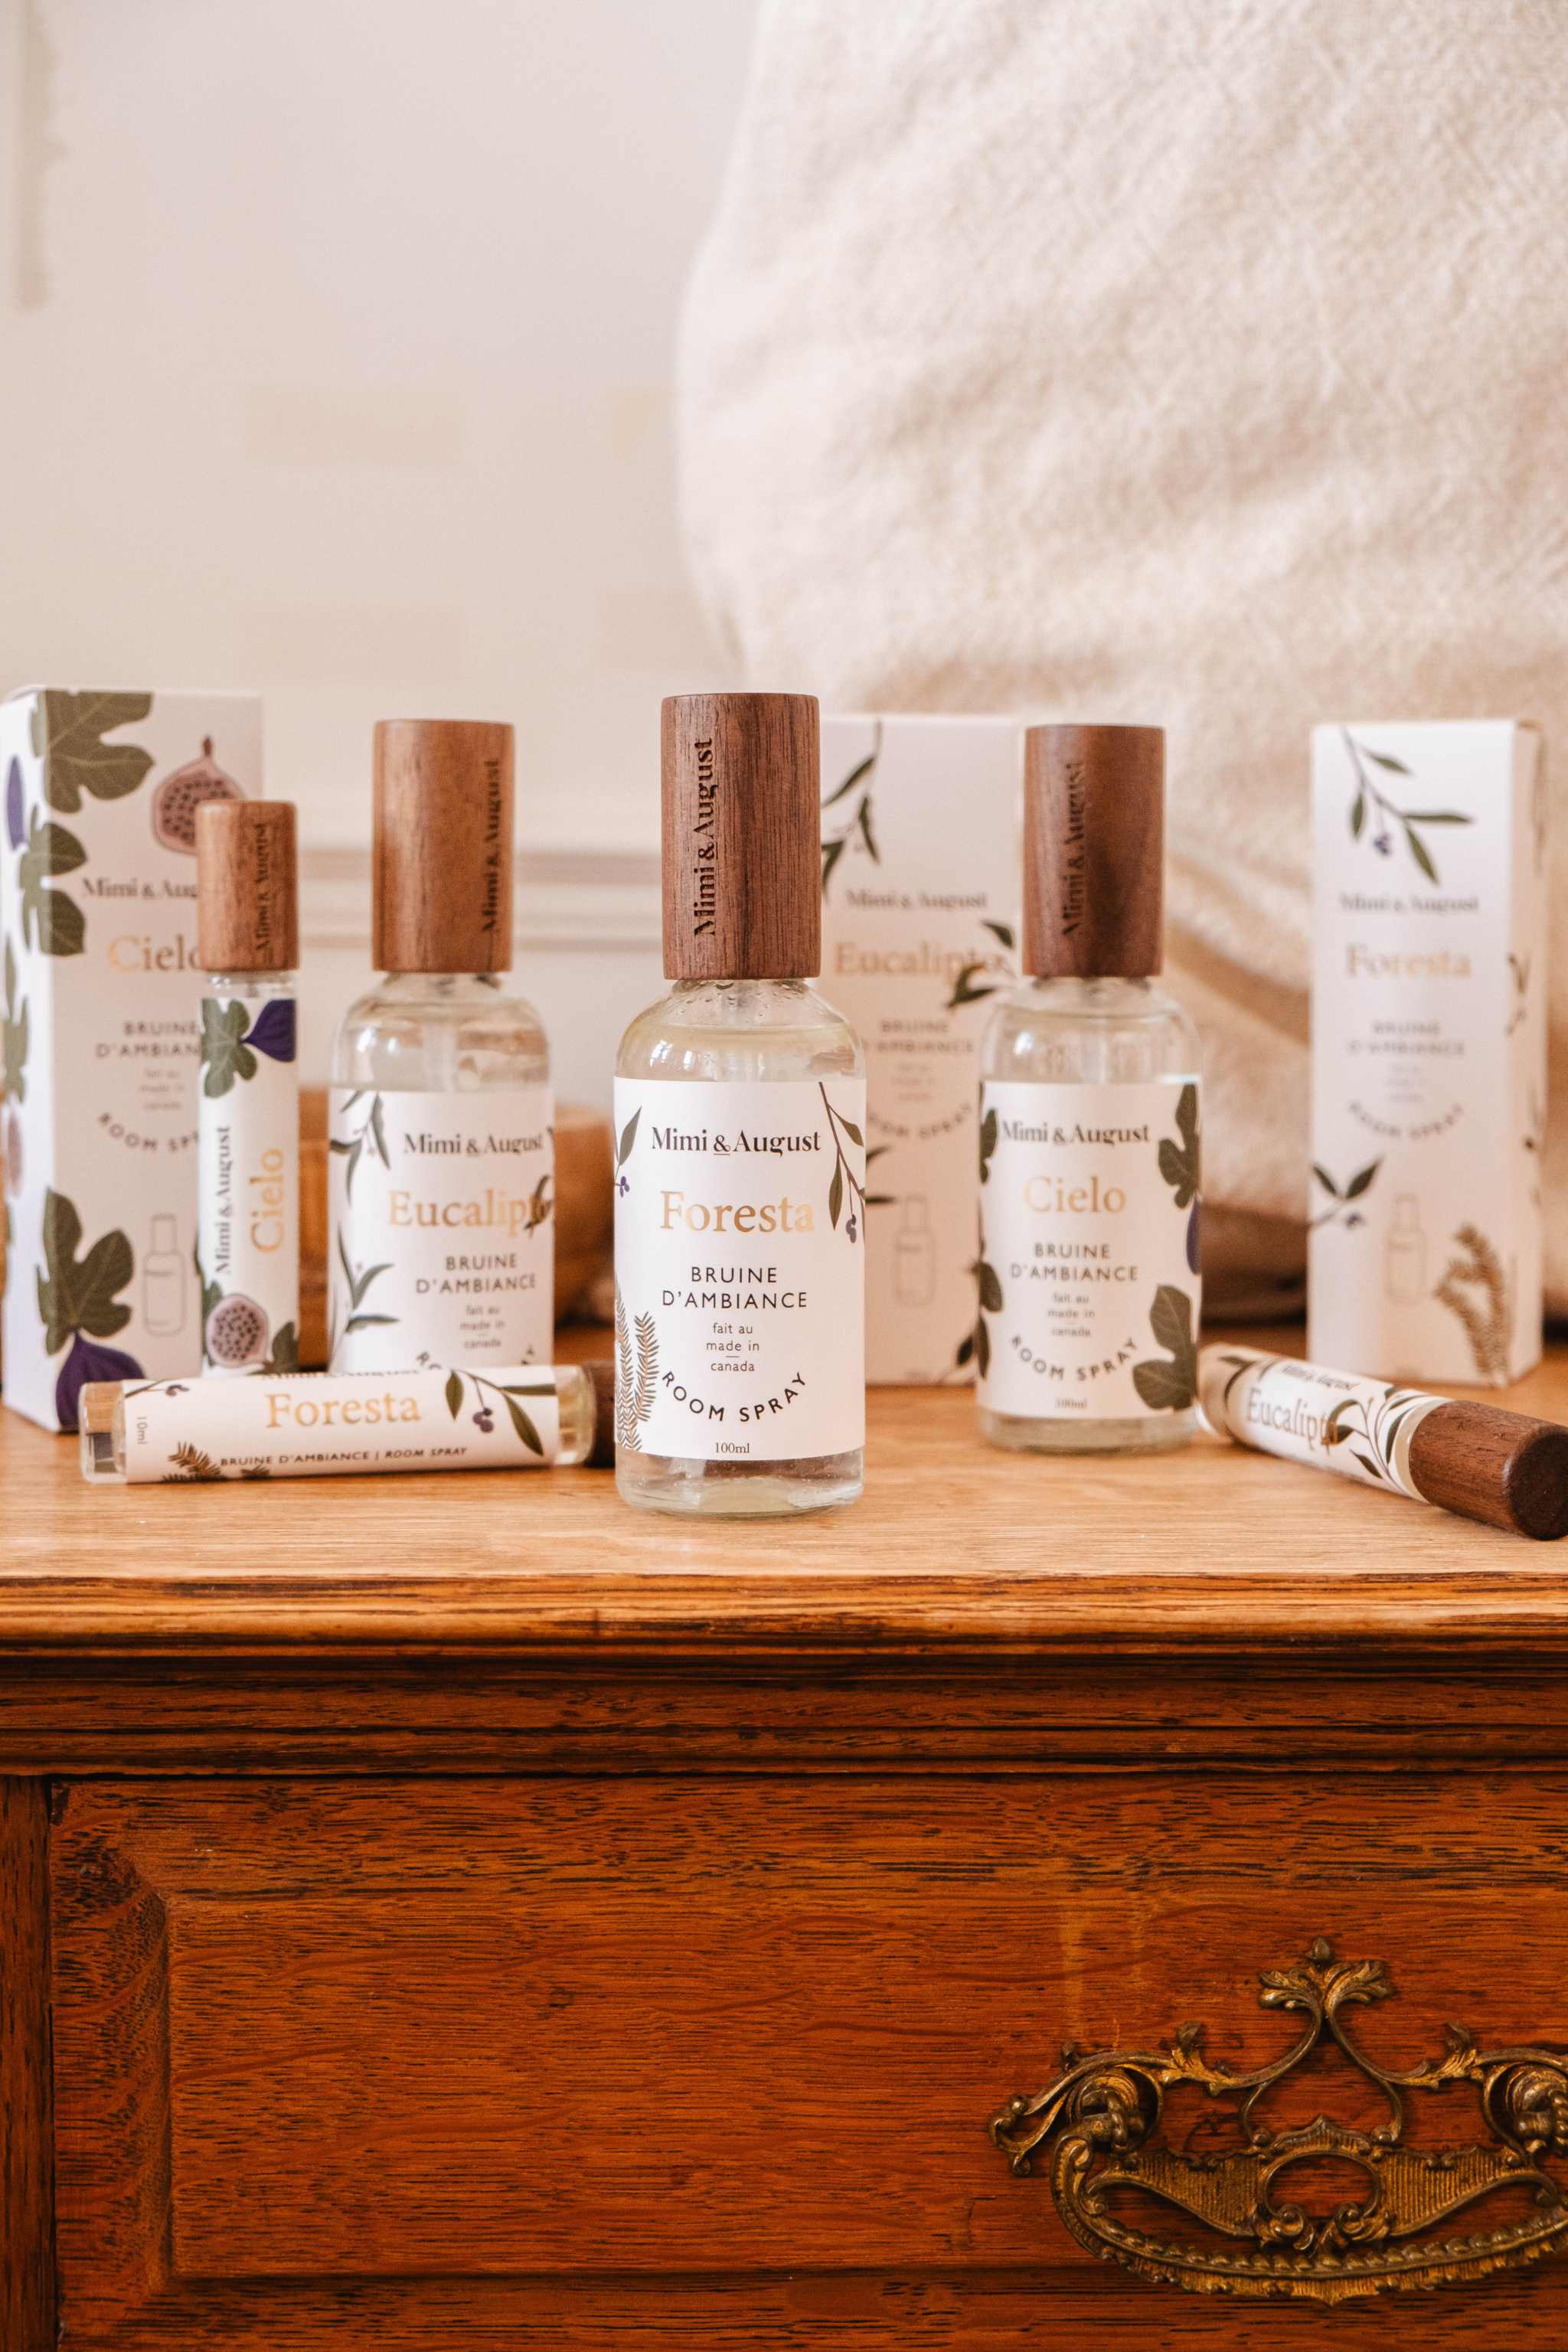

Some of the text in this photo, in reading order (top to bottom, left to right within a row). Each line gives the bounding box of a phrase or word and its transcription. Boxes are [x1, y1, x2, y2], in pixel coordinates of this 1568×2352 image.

[693, 737, 719, 936] Mimi & August
[81, 877, 139, 898] Mimi
[403, 1132, 544, 1155] Mimi & August
[651, 1126, 822, 1158] Mimi & August
[1001, 1122, 1150, 1145] Mimi & August
[216, 1126, 234, 1274] Mimi & August
[250, 1149, 283, 1253] Cielo
[1024, 1176, 1127, 1213] Cielo
[660, 1190, 815, 1233] Foresta
[1034, 1243, 1110, 1259] BRUINE
[446, 1253, 518, 1271] BRUINE
[691, 1266, 778, 1284] BRUINE
[1010, 1265, 1138, 1281] D'AMBIANCE
[416, 1276, 537, 1295] D'AMBIANCE
[662, 1289, 808, 1310] D'AMBIANCE
[712, 1322, 753, 1334] fait au
[1051, 1326, 1091, 1338] canada
[464, 1338, 502, 1350] canada
[706, 1341, 760, 1352] made in
[710, 1360, 756, 1373] canada
[1011, 1335, 1138, 1381] ROOM SPRAY
[662, 1370, 808, 1423] ROOM SPRAY
[266, 1392, 421, 1429] Foresta
[136, 1416, 148, 1445] 10ml
[220, 1457, 273, 1466] BRUINE
[279, 1452, 369, 1464] D'AMBIANCE
[384, 1450, 425, 1459] ROOM
[430, 1447, 467, 1457] SPRAY
[714, 1442, 751, 1455] 100ml
